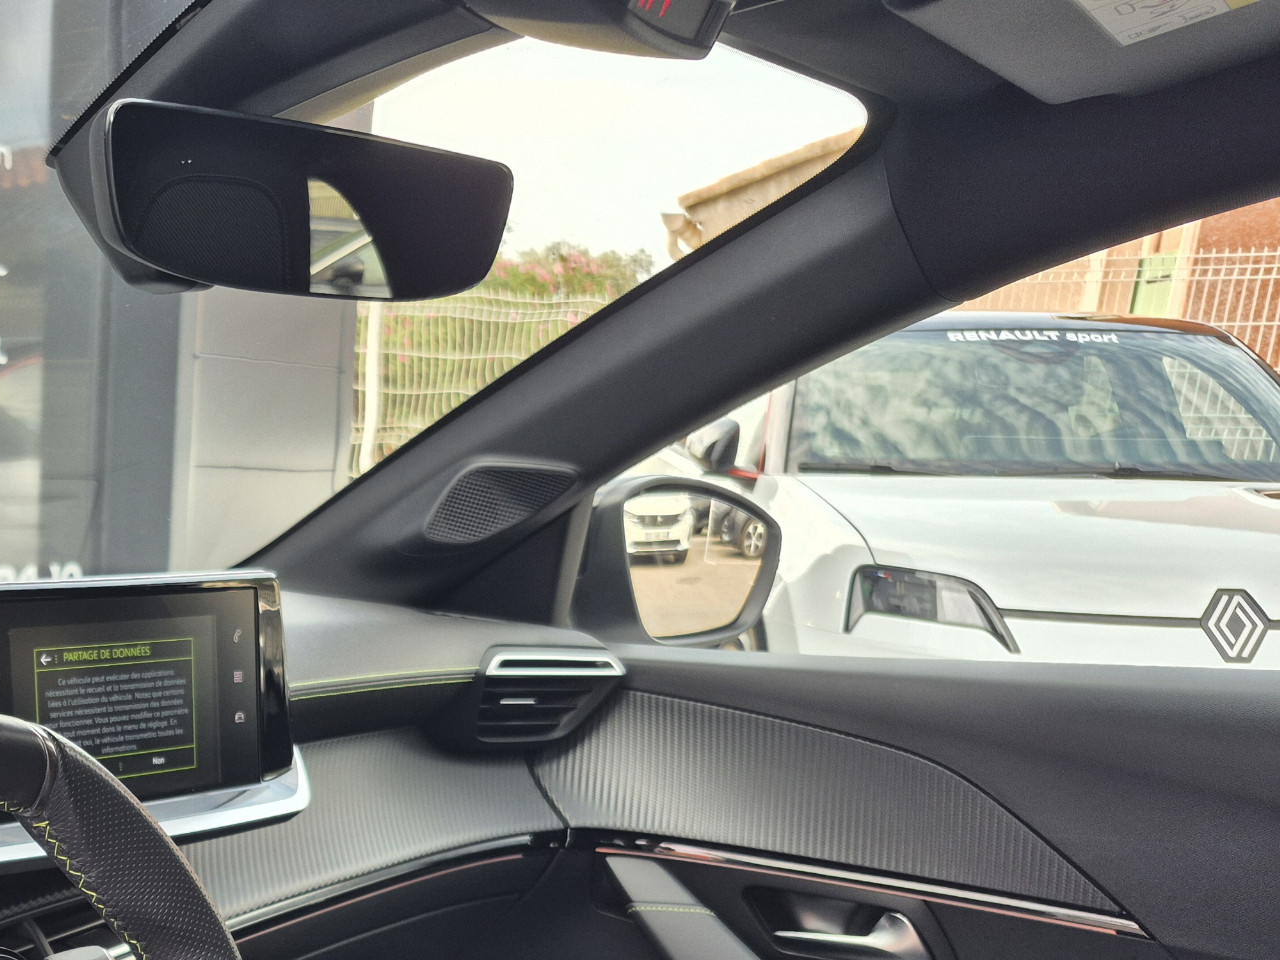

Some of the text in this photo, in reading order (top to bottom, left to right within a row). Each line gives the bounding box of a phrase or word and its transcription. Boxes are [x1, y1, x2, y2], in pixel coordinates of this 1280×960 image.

[947, 330, 1120, 344] RENAULT sport
[63, 645, 151, 662] PARTAGE DE DONNÉES
